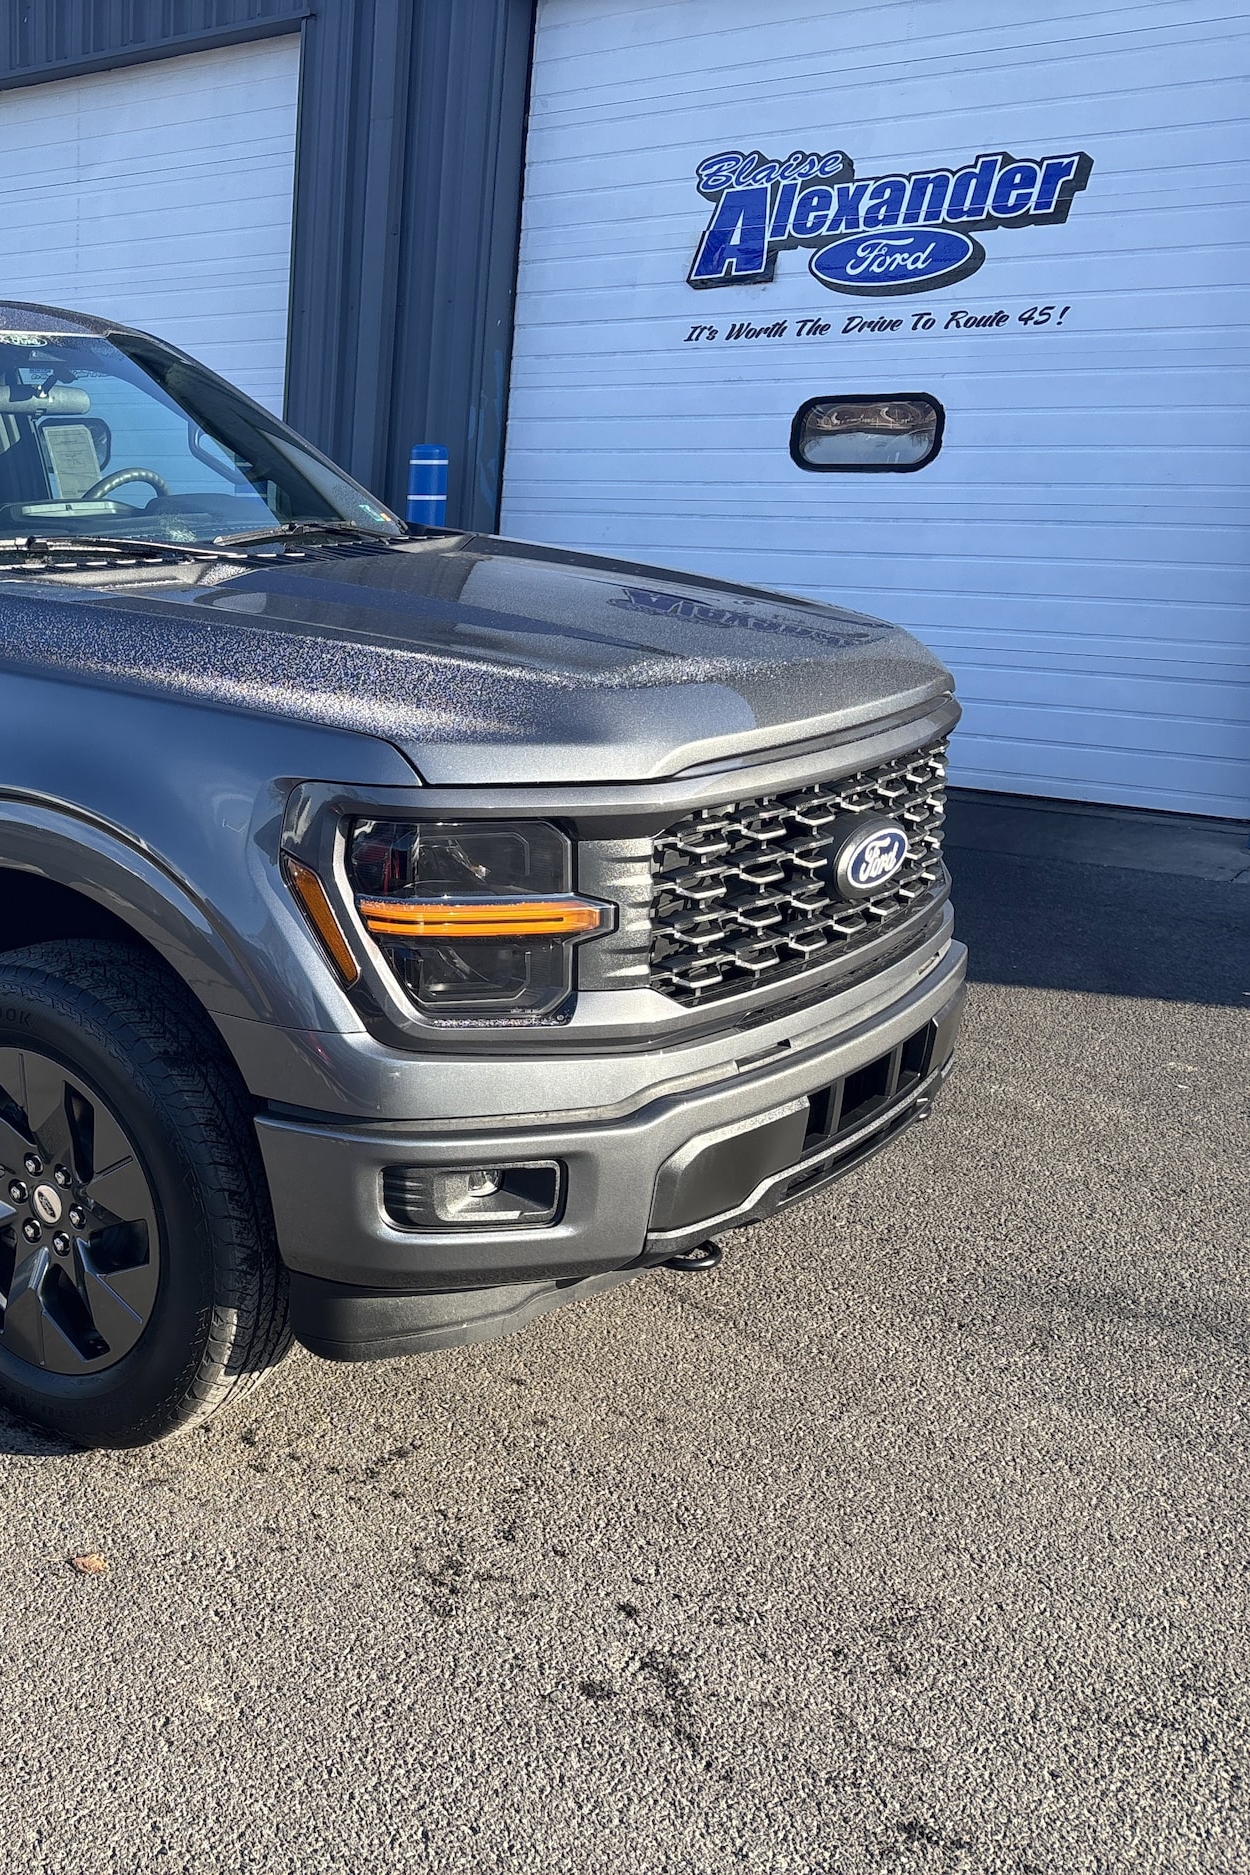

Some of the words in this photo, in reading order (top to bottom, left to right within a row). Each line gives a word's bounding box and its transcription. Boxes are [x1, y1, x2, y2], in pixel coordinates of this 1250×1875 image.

[697, 152, 844, 193] Blaise
[689, 154, 1083, 281] Alexander
[845, 236, 937, 276] Ford
[683, 324, 719, 342] It's
[724, 319, 788, 341] Worth
[795, 317, 832, 337] The
[841, 315, 904, 334] Drive
[910, 312, 936, 331] To
[943, 310, 1010, 330] Route
[858, 836, 900, 882] Ford
